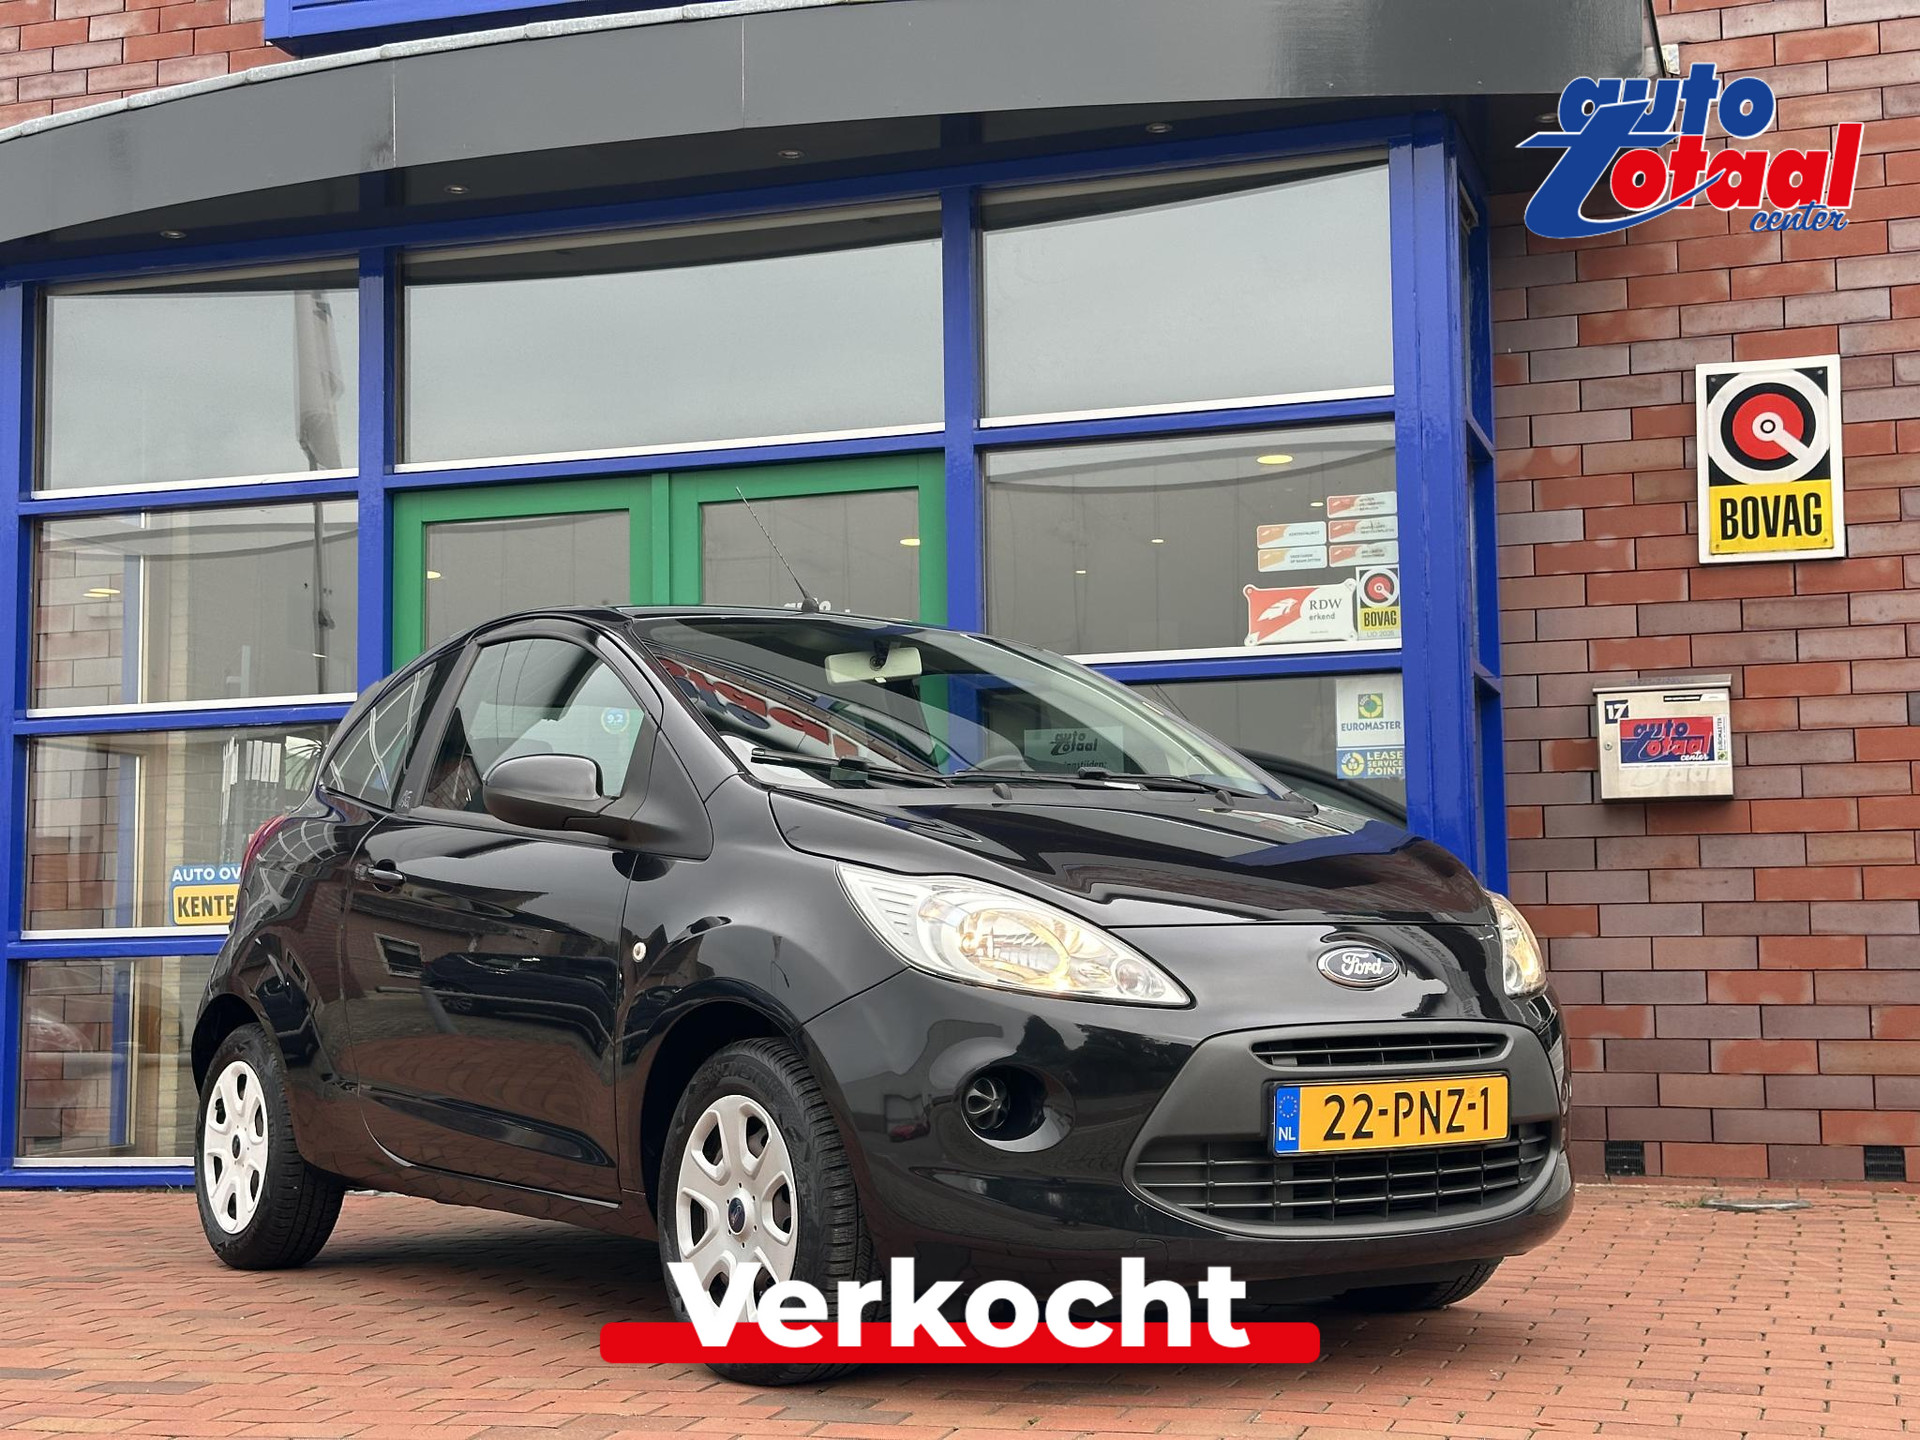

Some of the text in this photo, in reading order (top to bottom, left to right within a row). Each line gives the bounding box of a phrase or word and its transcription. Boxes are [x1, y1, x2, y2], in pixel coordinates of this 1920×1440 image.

[1719, 492, 1822, 541] BOVAG
[1309, 598, 1343, 610] RDW
[1309, 611, 1336, 621] erkend
[1363, 610, 1397, 627] BOVAG
[1605, 703, 1628, 720] 17
[1341, 721, 1401, 732] EUROMASTER
[1366, 750, 1403, 760] LEASE
[1680, 750, 1709, 761] center
[1367, 759, 1403, 768] SERVICE
[1367, 767, 1404, 776] POINT
[172, 866, 242, 882] AUTO OV
[177, 894, 235, 918] KENTE
[1340, 952, 1384, 976] Ford
[1323, 1085, 1490, 1142] 22-PNZ-1
[1278, 1126, 1297, 1141] NL
